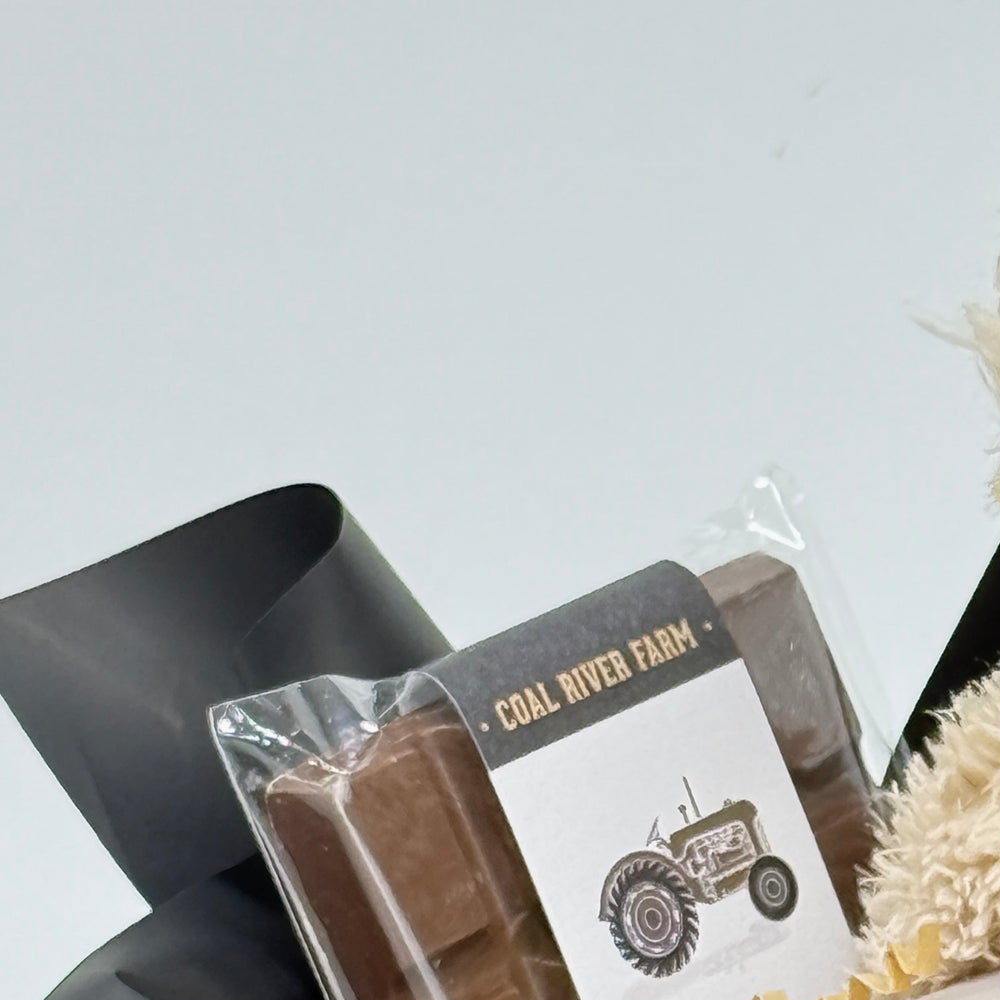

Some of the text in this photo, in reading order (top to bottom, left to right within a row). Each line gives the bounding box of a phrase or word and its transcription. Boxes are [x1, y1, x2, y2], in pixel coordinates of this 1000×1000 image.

[494, 617, 699, 731] COAL RIVER FARM
